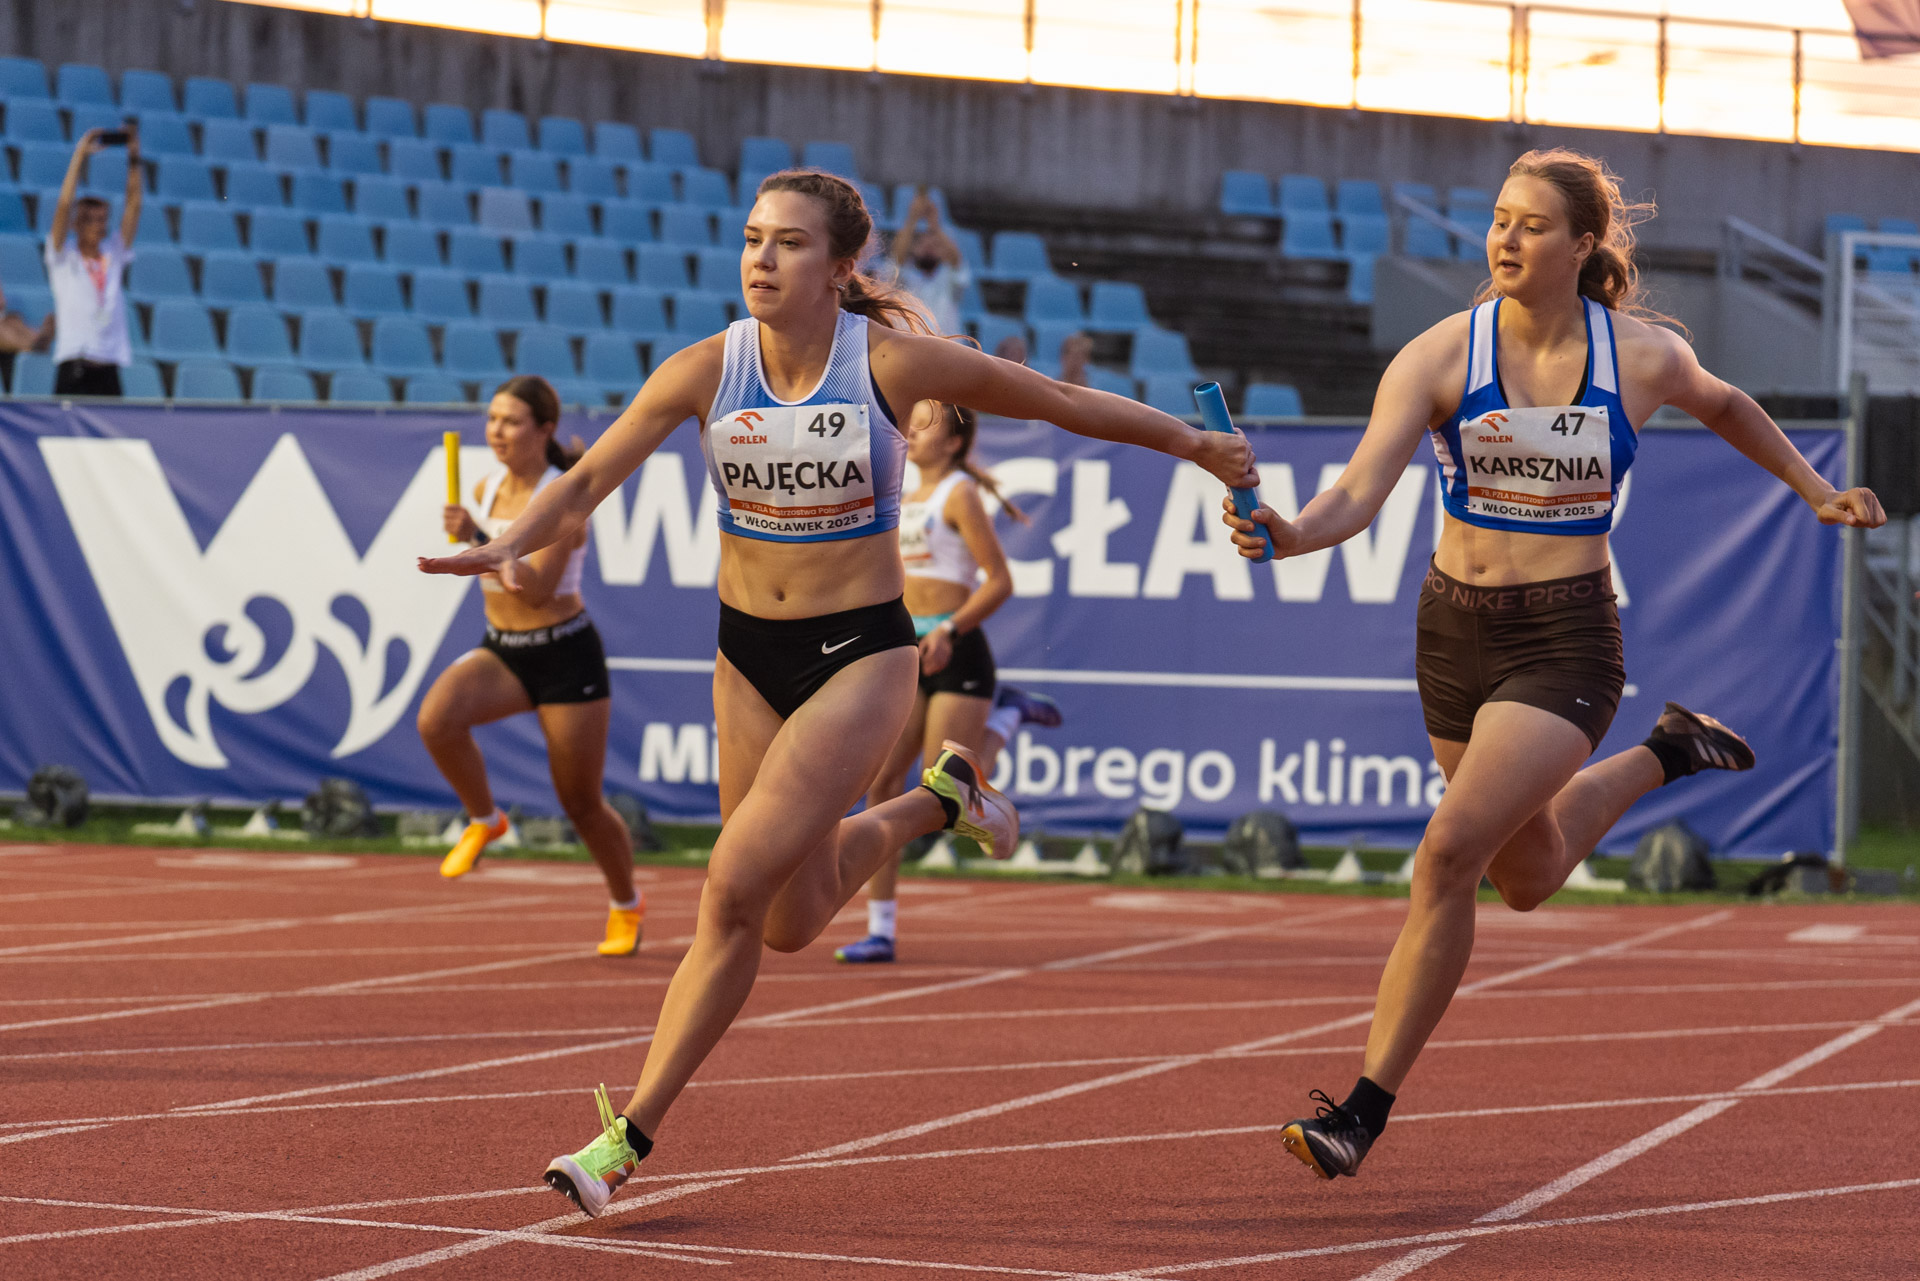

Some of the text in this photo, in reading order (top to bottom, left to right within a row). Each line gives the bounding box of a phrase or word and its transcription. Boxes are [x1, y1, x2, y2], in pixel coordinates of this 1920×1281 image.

[808, 412, 846, 438] 49
[1551, 412, 1586, 437] 47
[730, 435, 768, 445] ORLEN
[1477, 435, 1513, 443] ORLEN
[722, 460, 866, 496] PAJĘCKA
[1469, 456, 1605, 482] KARSZNIA
[1511, 493, 1556, 505] Mistrzostwa
[1557, 495, 1581, 504] Polski
[1582, 493, 1599, 501] U20
[769, 507, 817, 517] Mistrzostwa
[818, 504, 843, 514] Polski
[844, 501, 861, 511] U20
[1482, 502, 1595, 518] WŁOCŁAWEK 2025
[745, 513, 859, 532] WŁOCŁAWEK 2025
[1425, 568, 1446, 594] RO
[1452, 585, 1519, 610] NIKE
[1524, 580, 1593, 608] PRO
[500, 630, 550, 648] NIKE
